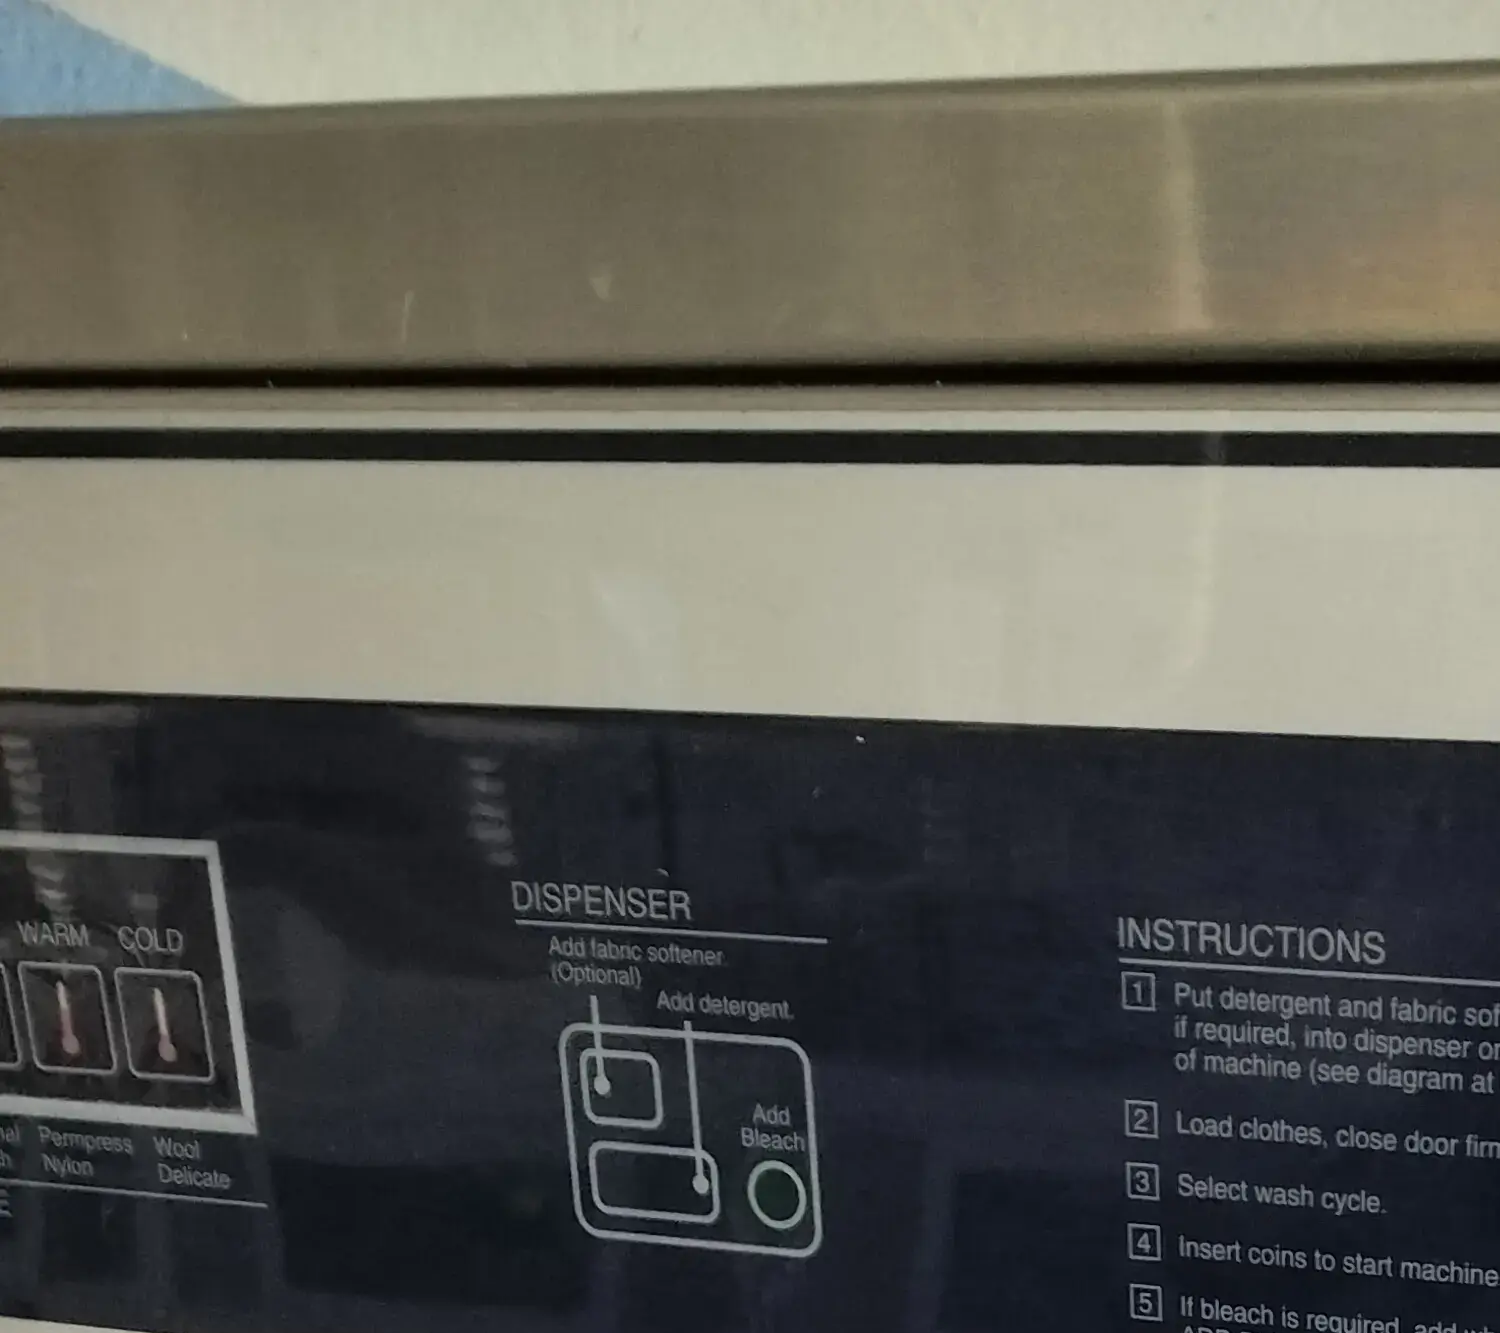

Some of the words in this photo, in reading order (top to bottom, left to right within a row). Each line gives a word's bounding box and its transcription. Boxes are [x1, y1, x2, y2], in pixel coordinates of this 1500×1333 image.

[511, 881, 692, 921] DISPENSER
[17, 920, 90, 947] WARM
[117, 926, 184, 953] COLD
[549, 935, 587, 957] Add
[590, 936, 642, 961] fabric
[1117, 916, 1387, 965] INSTRUCTIONS
[550, 961, 642, 989] (Optional)
[657, 990, 694, 1012] Add
[1174, 982, 1214, 1007] Put
[1219, 987, 1331, 1020] detergent
[1338, 994, 1383, 1021] and
[1389, 995, 1457, 1024] fabric
[1174, 1016, 1188, 1038] if
[1194, 1021, 1298, 1052] required,
[1304, 1026, 1348, 1051] into
[1354, 1030, 1471, 1061] dispenser
[1174, 1048, 1197, 1071] of
[1203, 1049, 1301, 1081] machine
[1308, 1058, 1360, 1086] (see
[1367, 1061, 1463, 1096] diagram
[1472, 1068, 1495, 1094] at
[752, 1103, 790, 1126] Add
[37, 1126, 134, 1154] Permpress
[153, 1135, 200, 1160] Wool
[740, 1127, 805, 1151] Bleach
[1176, 1111, 1233, 1138] Load
[1239, 1117, 1329, 1150] clothes,
[1335, 1125, 1397, 1152] close
[1404, 1130, 1458, 1156] door
[40, 1154, 94, 1178] Nylon
[157, 1163, 231, 1189] Delicate
[1177, 1173, 1248, 1202] Select
[1254, 1180, 1314, 1208] wash
[1320, 1186, 1388, 1217] cycle.
[1178, 1234, 1242, 1263] Insert
[1248, 1242, 1307, 1270] coins
[1314, 1249, 1335, 1272] to
[1343, 1250, 1393, 1277] start
[1180, 1295, 1196, 1317] If
[1201, 1297, 1273, 1326] bleach
[1281, 1304, 1299, 1328] is
